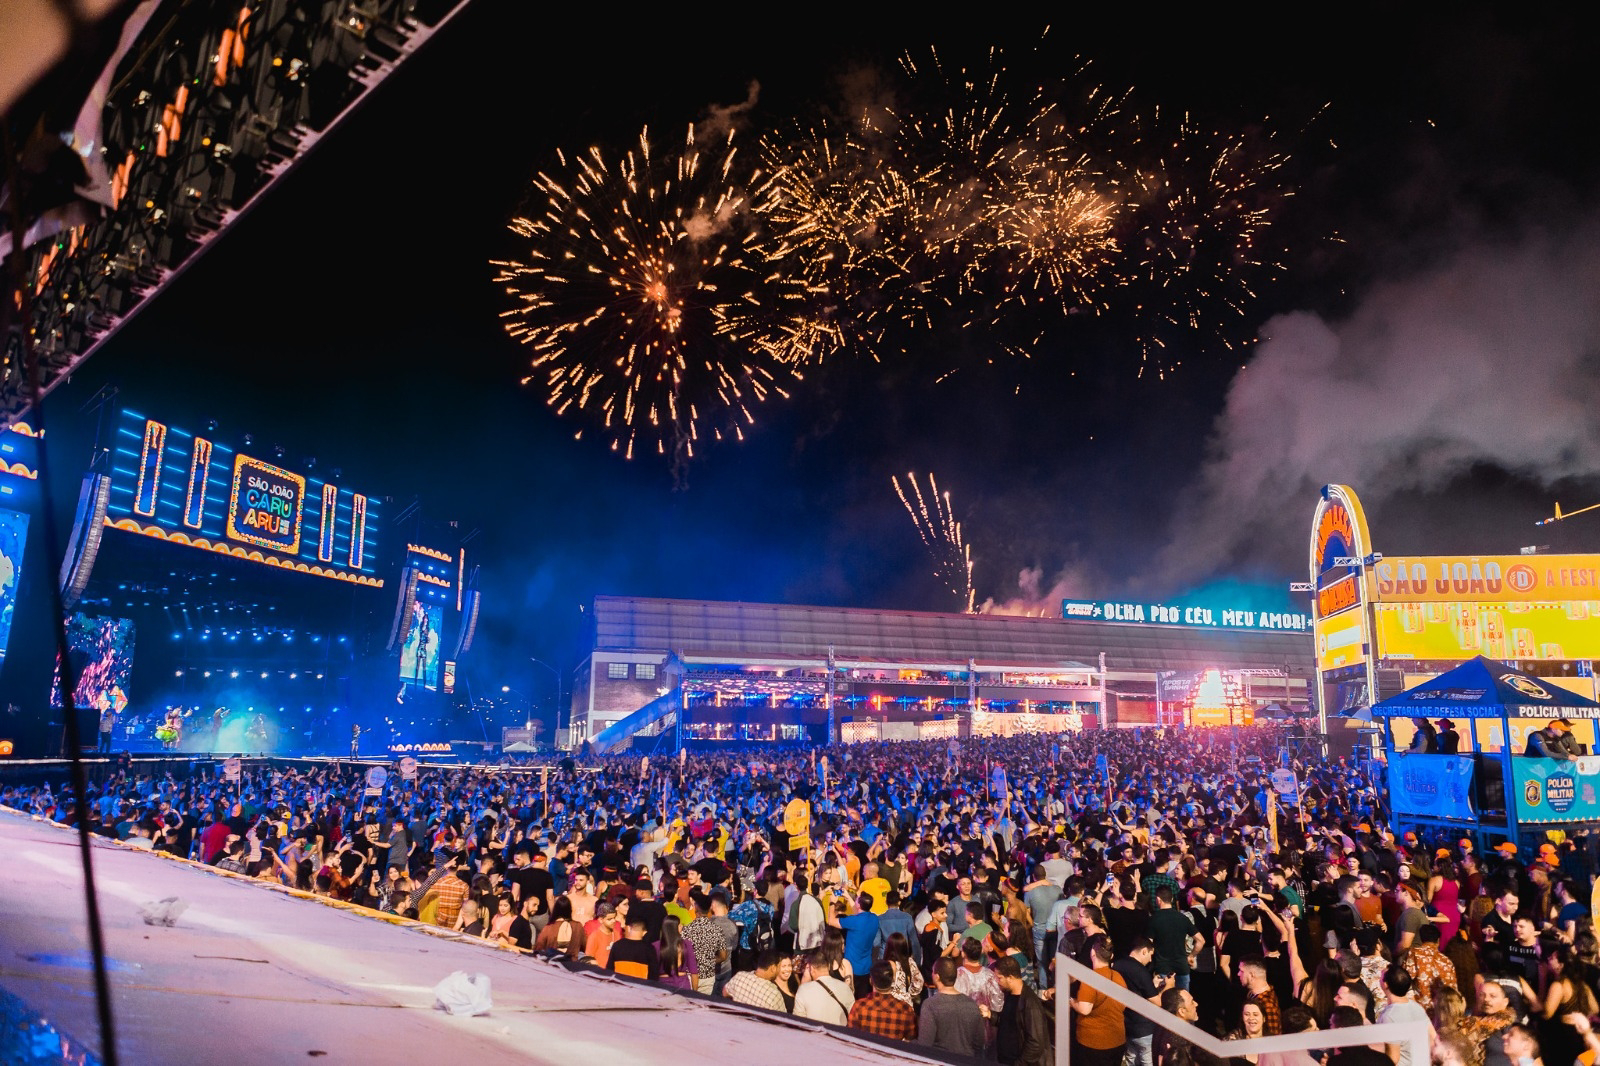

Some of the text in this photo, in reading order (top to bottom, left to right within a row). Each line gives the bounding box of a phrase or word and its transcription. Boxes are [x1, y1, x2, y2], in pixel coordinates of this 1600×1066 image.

[248, 476, 293, 500] SÃO JOÃO
[246, 489, 292, 518] CARU
[243, 508, 280, 534] ARU
[1379, 560, 1427, 595] SÃO
[1435, 558, 1502, 594] JOÃO
[1546, 569, 1555, 586] A
[1560, 569, 1600, 587] FEST
[1104, 603, 1144, 622] OLHA
[1151, 604, 1180, 622] PRO
[1222, 609, 1253, 626] MEU
[1259, 611, 1305, 630] AMOR!
[1373, 706, 1499, 717] SECRETARIA DE DEFESA SOCIAL
[1519, 705, 1600, 719] POLÍCIA MILITAR
[1547, 789, 1574, 799] MILITAR
[1548, 777, 1573, 788] POLÍCIA
